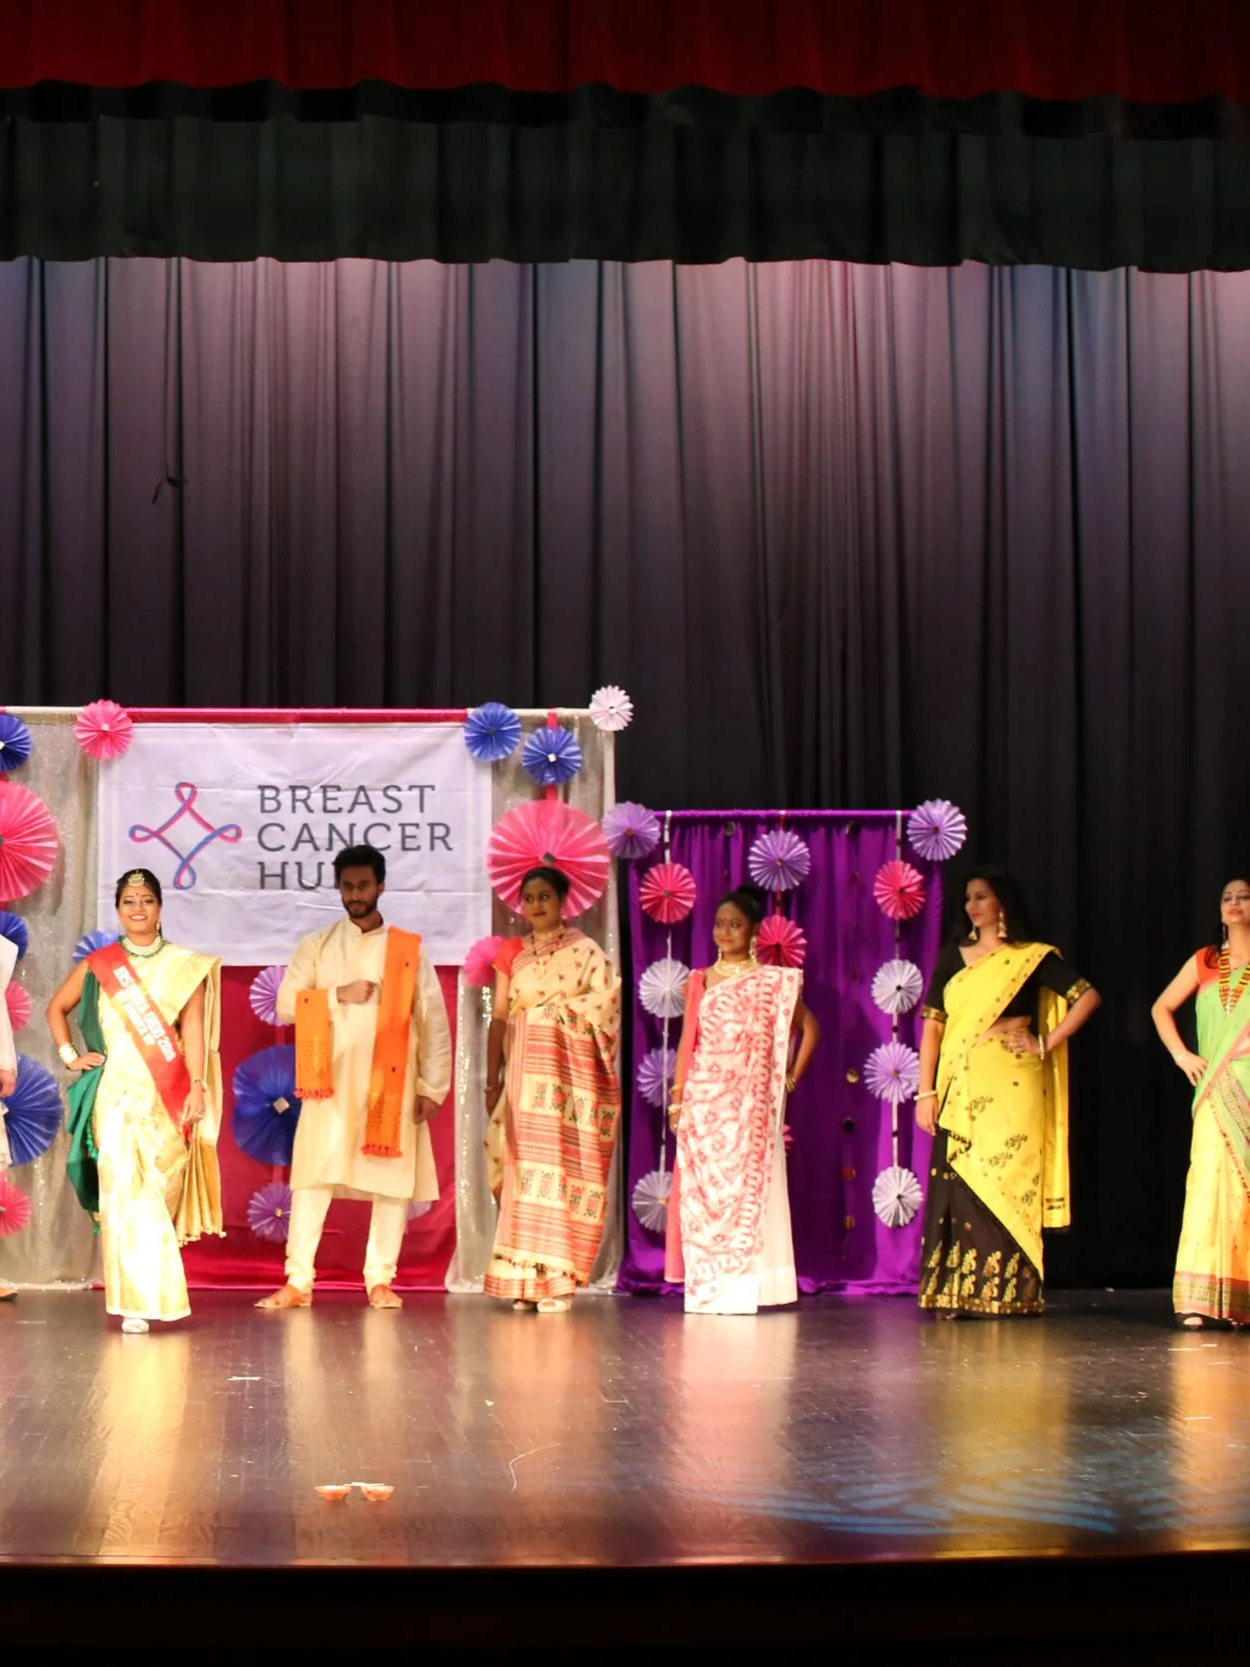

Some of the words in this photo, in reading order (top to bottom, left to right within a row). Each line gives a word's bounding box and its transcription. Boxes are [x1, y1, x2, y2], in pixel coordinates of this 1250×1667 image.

[257, 784, 436, 814] BREAST
[257, 822, 454, 852] CANCER
[257, 861, 340, 890] HU
